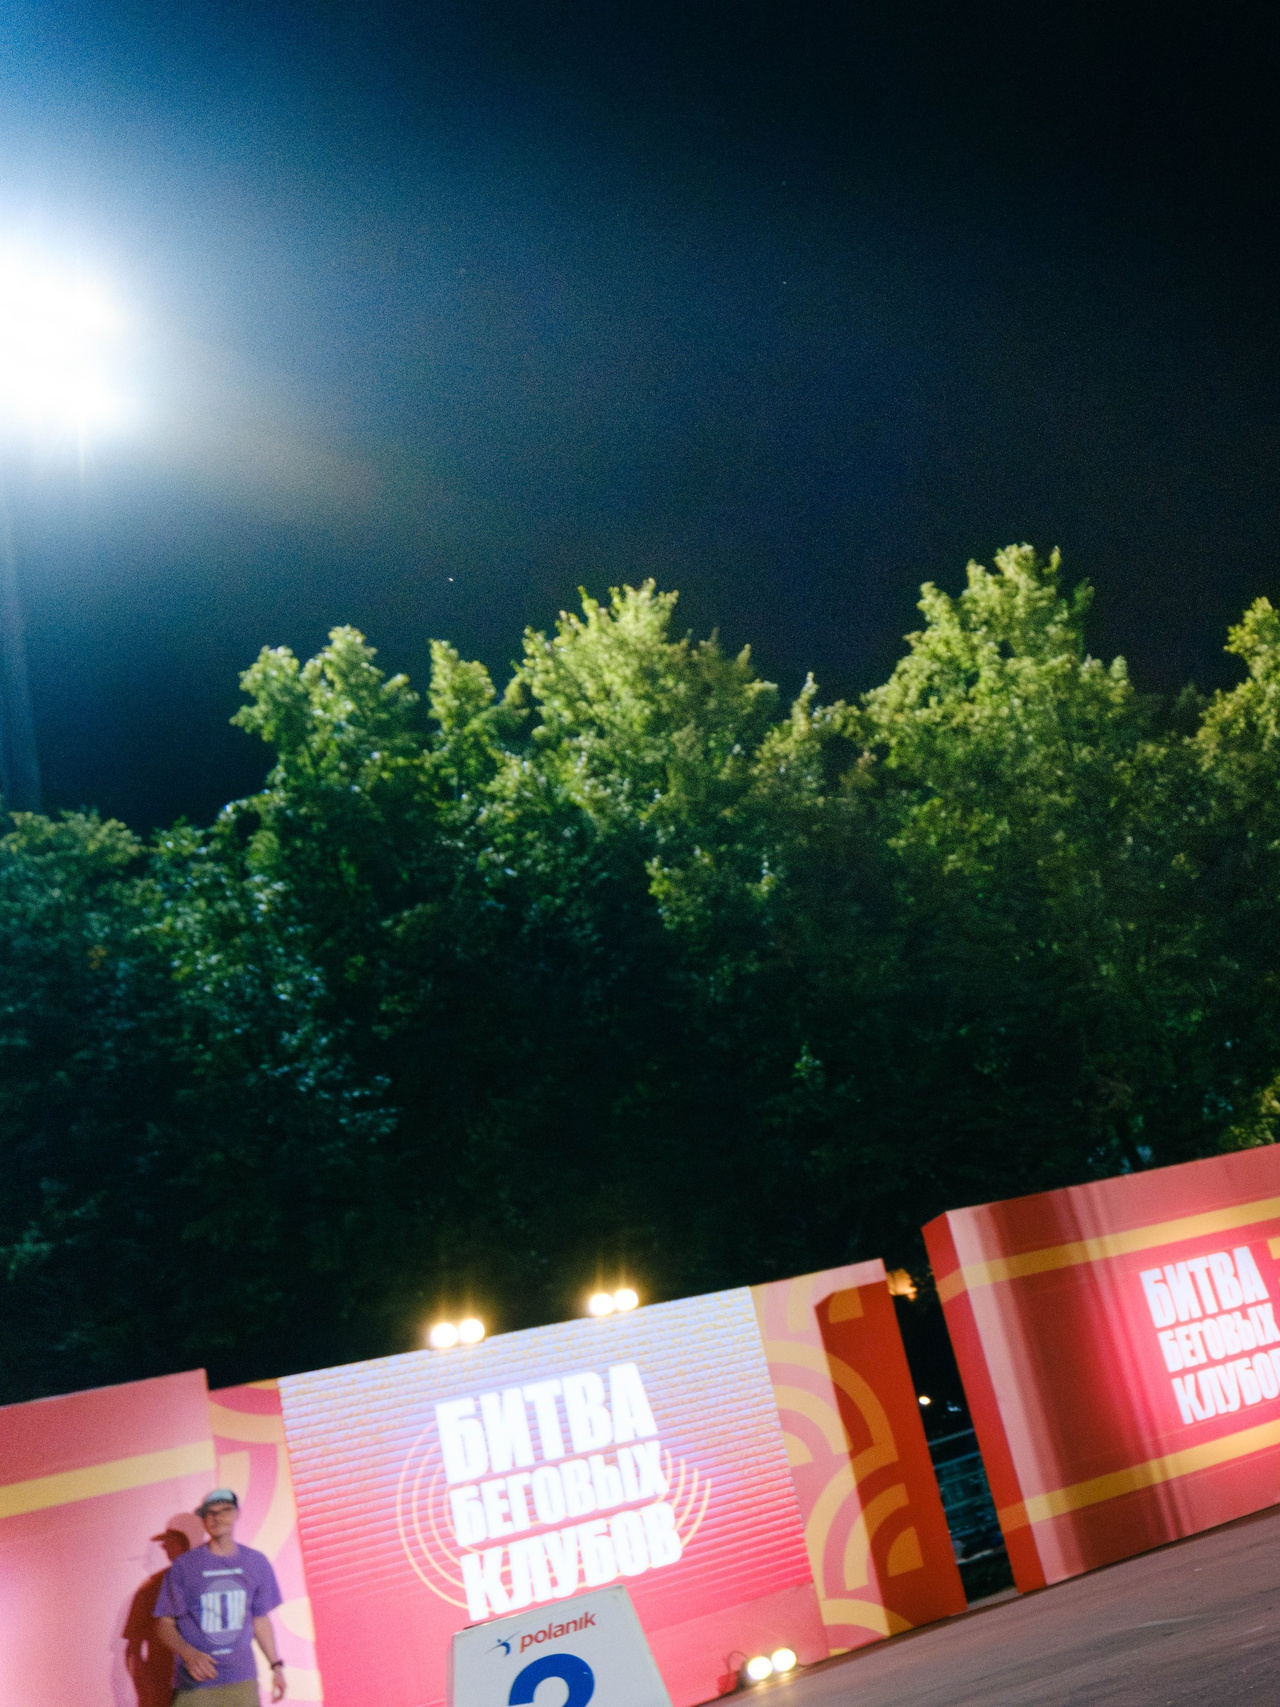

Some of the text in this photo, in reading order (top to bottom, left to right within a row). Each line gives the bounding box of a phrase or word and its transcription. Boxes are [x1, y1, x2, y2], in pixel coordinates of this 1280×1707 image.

[1139, 1246, 1270, 1329] БИТВА
[434, 1362, 658, 1485] БИТВА
[449, 1440, 669, 1547] БЕГОВЫХ
[460, 1502, 682, 1621] КЛУБОВ
[519, 1611, 597, 1653] polanik
